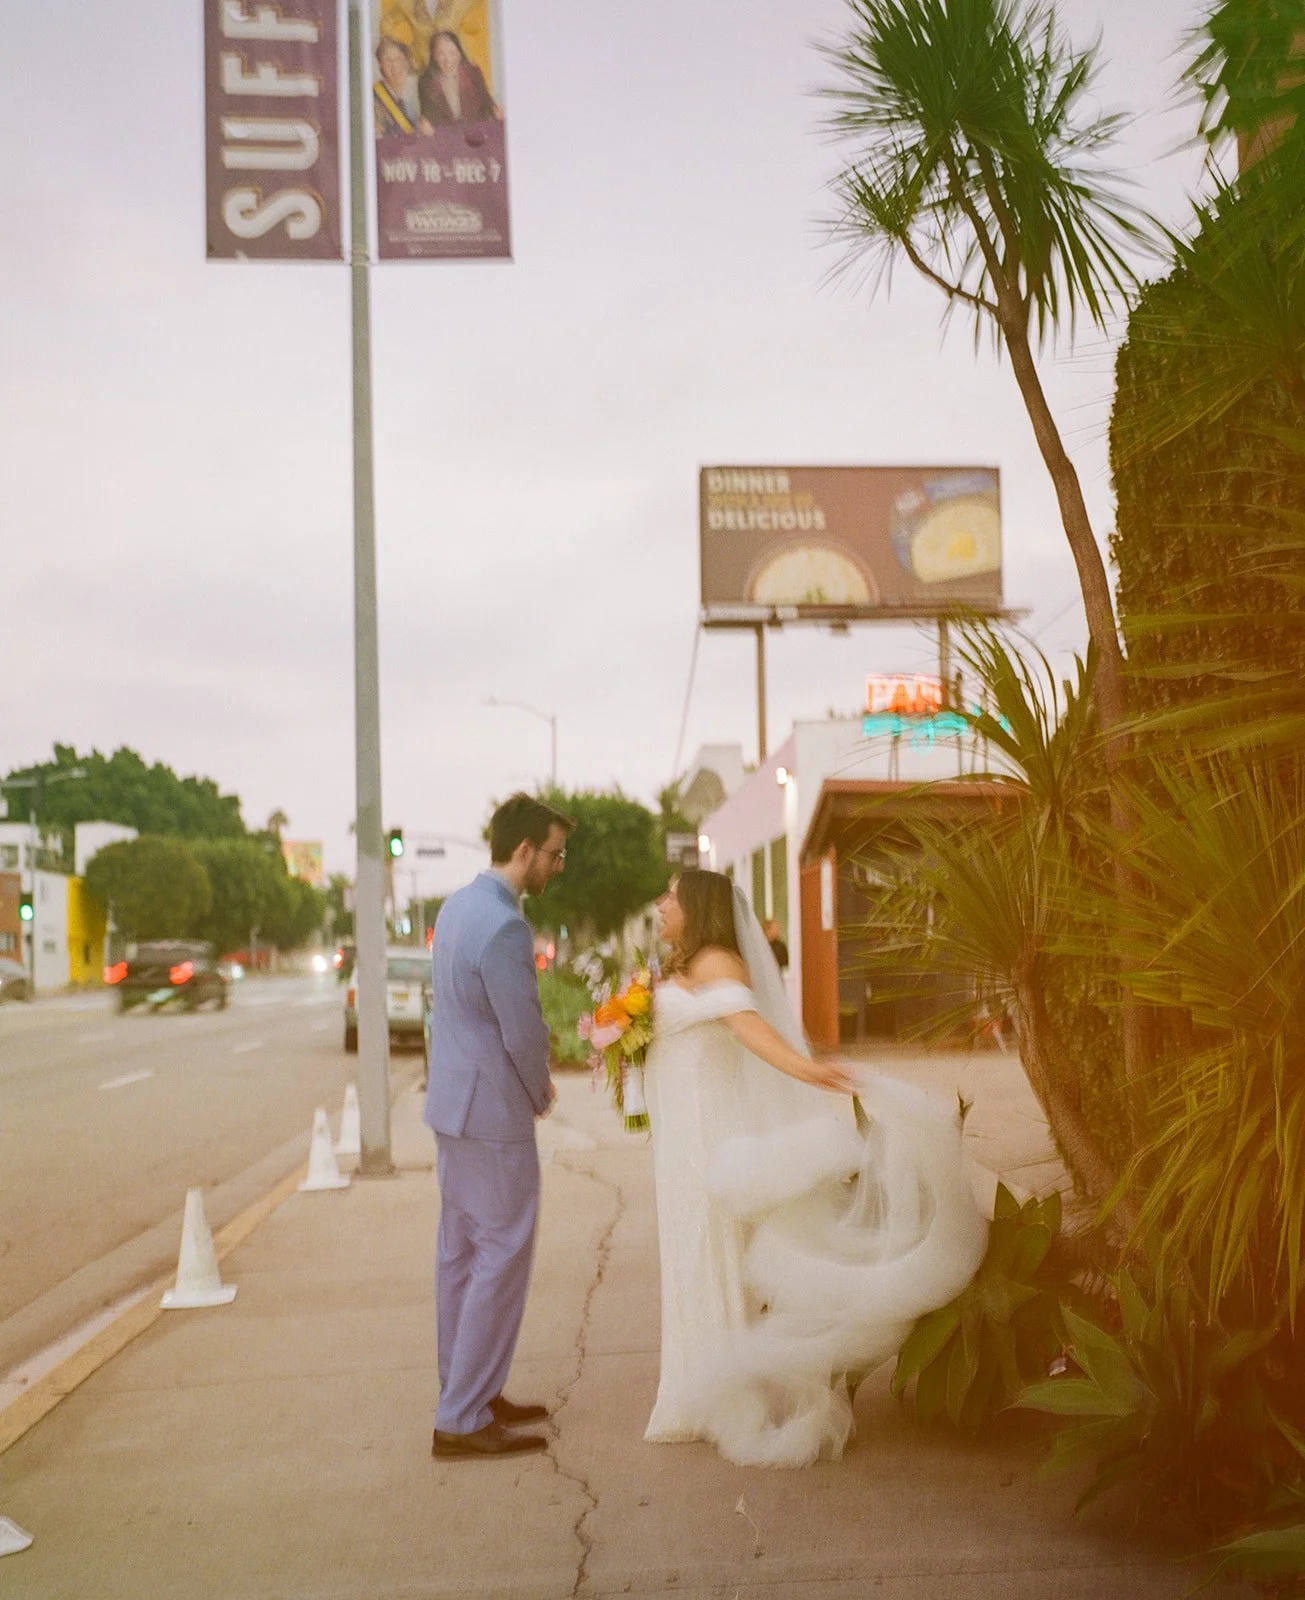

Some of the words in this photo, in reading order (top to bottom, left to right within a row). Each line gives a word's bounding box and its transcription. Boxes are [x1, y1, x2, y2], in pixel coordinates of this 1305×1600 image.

[220, 0, 325, 241] SUFF
[382, 158, 416, 184] NOV
[453, 158, 486, 184] DEC
[488, 158, 501, 184] 7
[707, 469, 789, 493] DINNER
[707, 506, 826, 531] DELICIOUS
